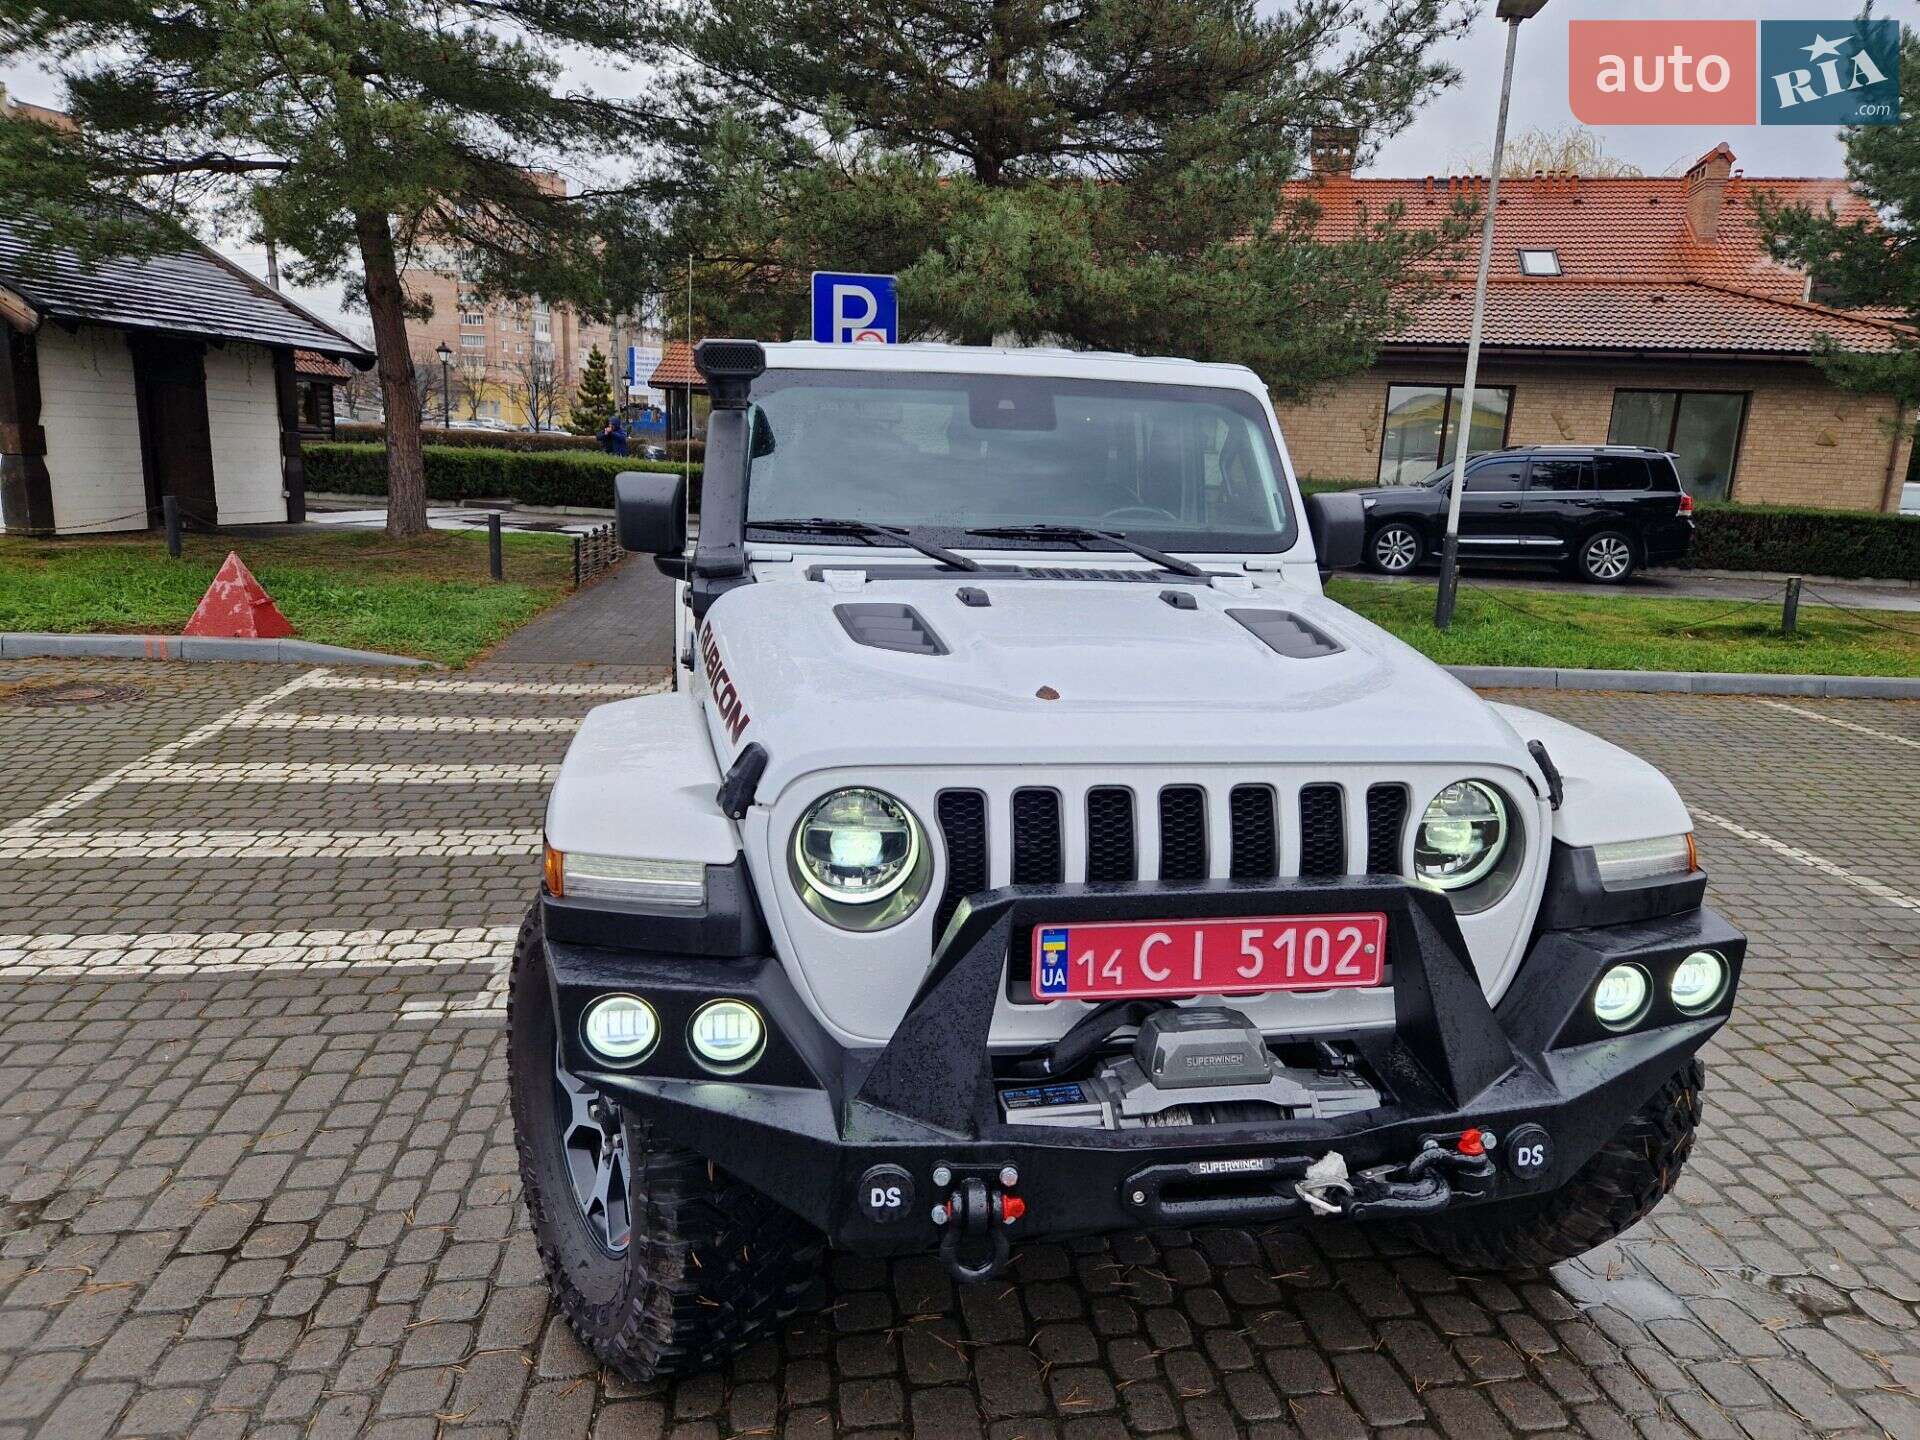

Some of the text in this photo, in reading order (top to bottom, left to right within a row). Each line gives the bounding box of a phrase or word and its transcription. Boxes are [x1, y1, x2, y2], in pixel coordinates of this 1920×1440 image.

[832, 283, 878, 345] P
[699, 619, 751, 747] RUBICON
[1076, 949, 1123, 987] 14
[1236, 926, 1364, 980] 5102
[1041, 968, 1067, 987] UA
[1186, 1055, 1244, 1068] SUPERWINCH
[1199, 1158, 1264, 1174] SUPERWINCH
[1517, 1144, 1544, 1166] DS
[870, 1186, 902, 1208] DS
